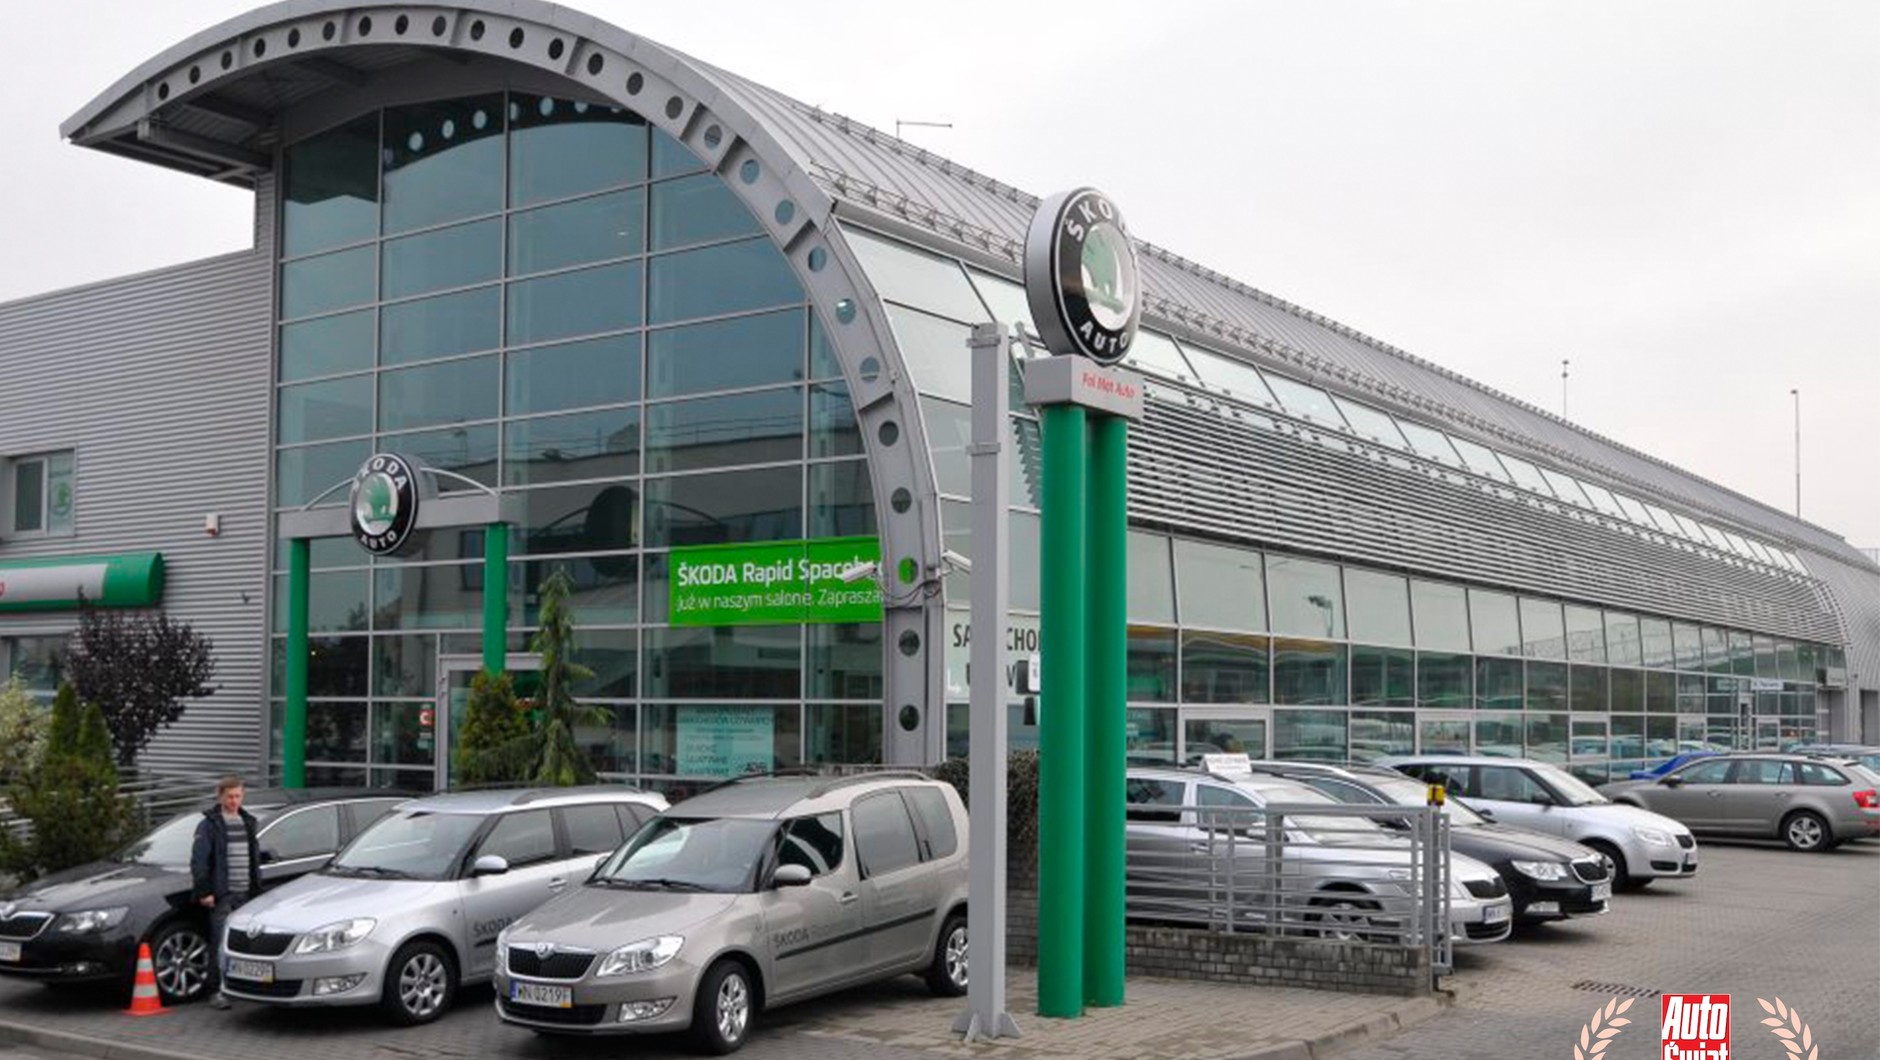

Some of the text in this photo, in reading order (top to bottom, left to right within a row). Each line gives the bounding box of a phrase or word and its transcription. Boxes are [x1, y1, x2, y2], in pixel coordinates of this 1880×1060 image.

[1080, 320, 1128, 353] AUTO
[361, 531, 397, 549] AUTO
[678, 561, 738, 587] ŠKODA
[742, 558, 793, 587] Rapid
[698, 596, 711, 609] w
[713, 595, 762, 612] naszym
